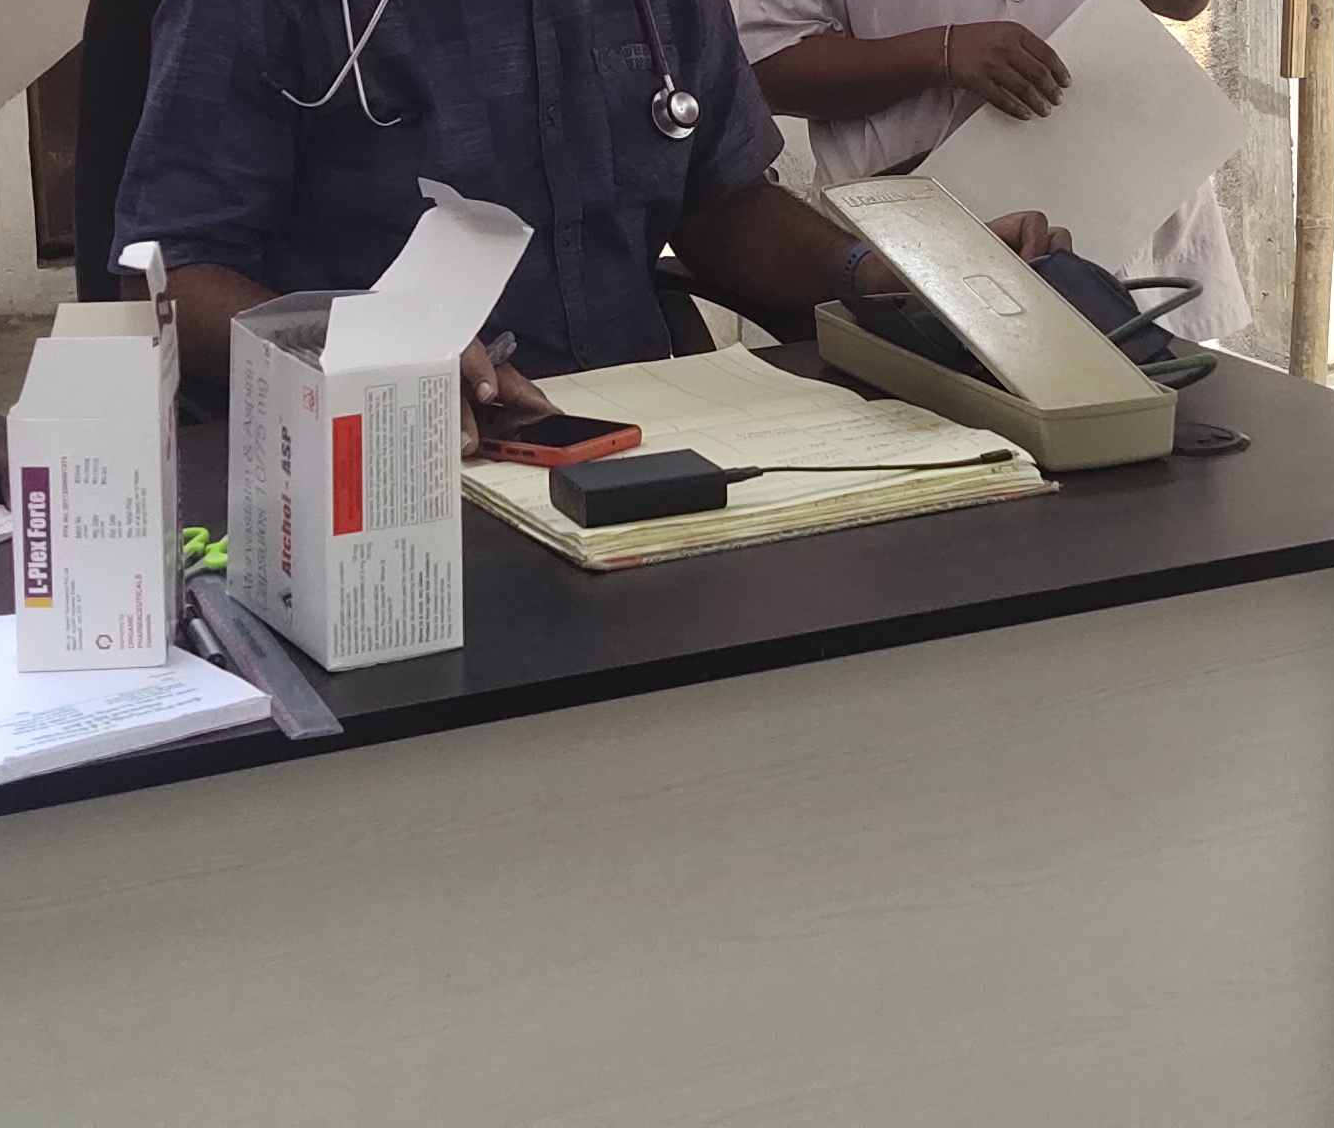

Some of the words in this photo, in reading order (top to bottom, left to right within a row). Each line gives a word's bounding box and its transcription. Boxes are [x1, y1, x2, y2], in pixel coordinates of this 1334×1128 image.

[280, 425, 292, 475] ASP
[27, 490, 47, 540] Forte
[280, 493, 293, 578] Atchol
[28, 541, 50, 594] L-Plex
